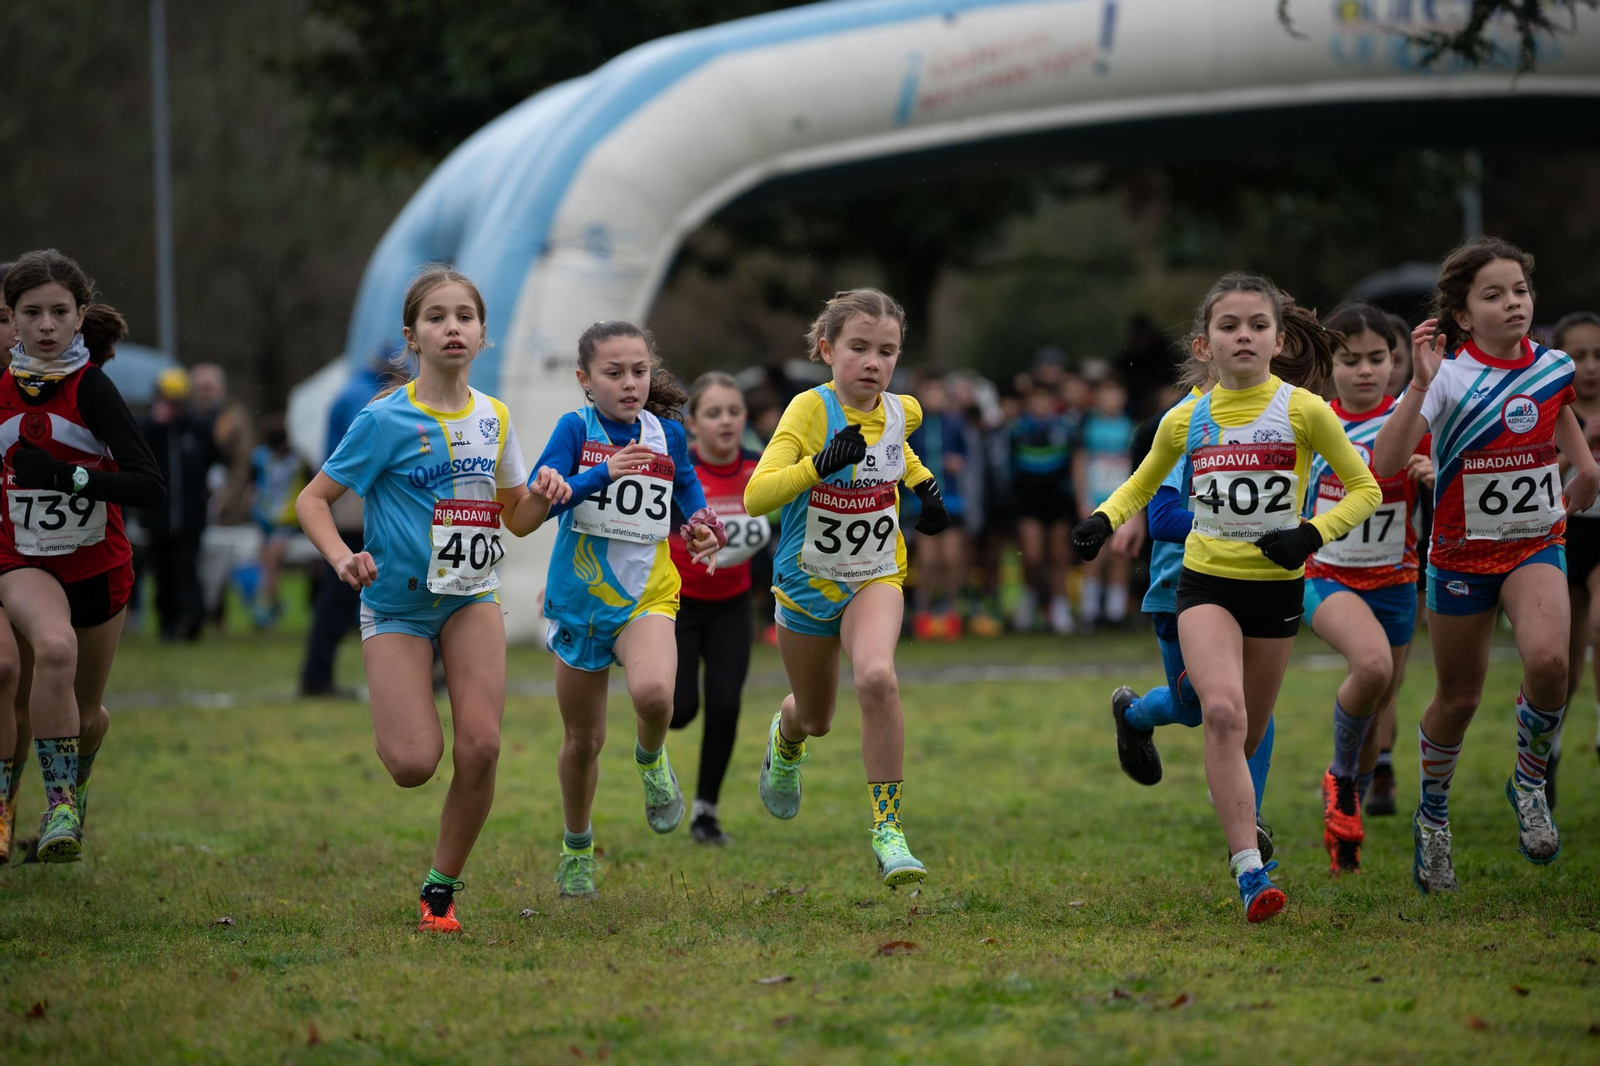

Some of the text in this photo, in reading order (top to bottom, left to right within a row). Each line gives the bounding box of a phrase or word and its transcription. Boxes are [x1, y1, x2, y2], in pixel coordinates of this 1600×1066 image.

[1203, 446, 1234, 454] Memorial
[1235, 444, 1268, 452] Alejandro
[652, 462, 674, 477] 2026
[1192, 453, 1295, 472] RIBADAVIA 2026
[1464, 453, 1535, 470] RIBADAVIA
[586, 479, 667, 520] 403
[811, 490, 876, 509] RIBADAVIA
[1196, 475, 1292, 516] 402
[1478, 471, 1555, 516] 621
[15, 494, 96, 531] 739
[434, 508, 491, 523] RIBADAVIA
[814, 515, 894, 556] 399
